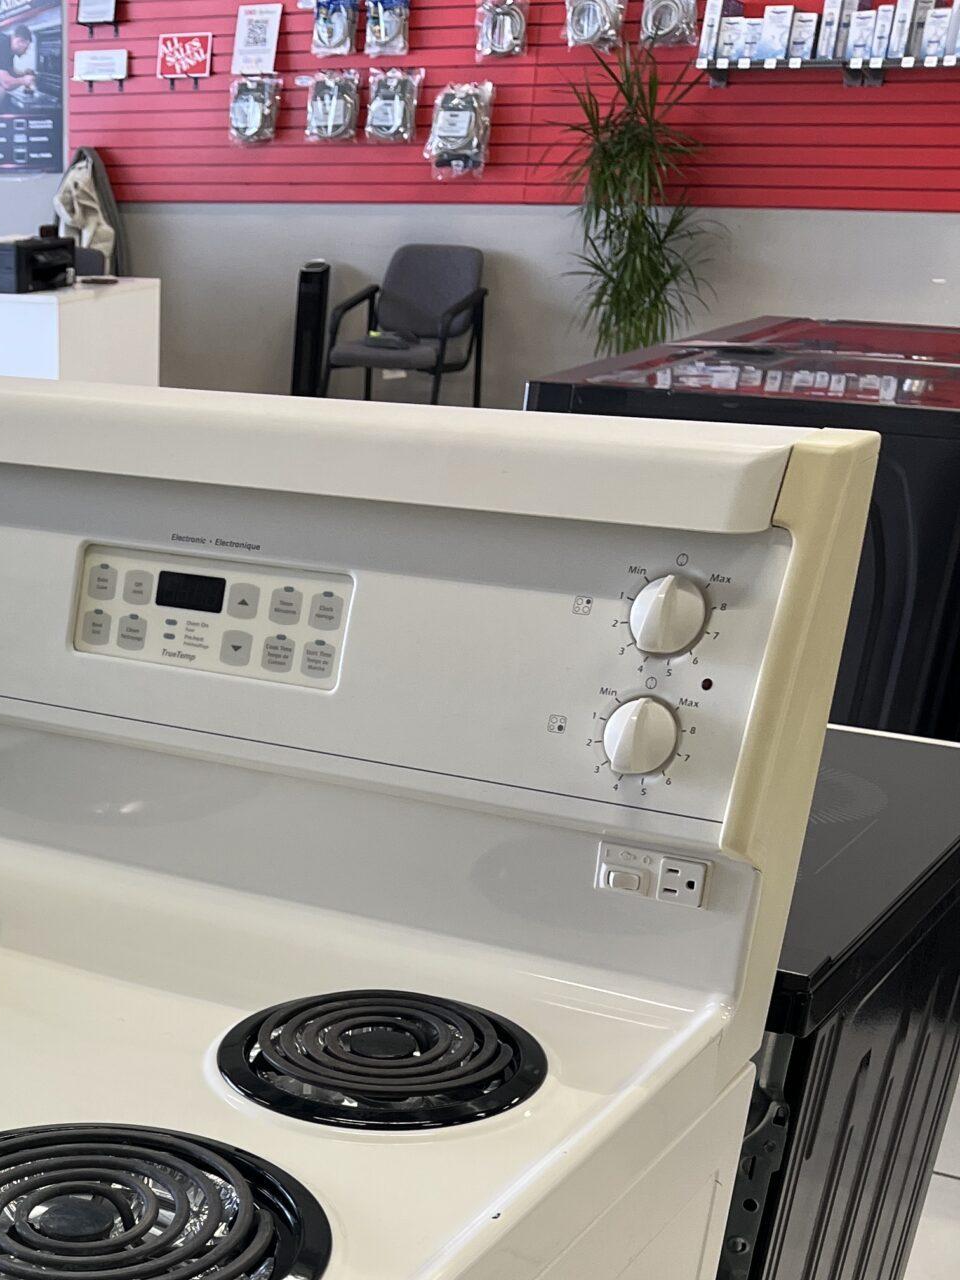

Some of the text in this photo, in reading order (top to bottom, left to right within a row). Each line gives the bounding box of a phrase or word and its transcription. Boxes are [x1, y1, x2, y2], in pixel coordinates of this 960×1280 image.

[171, 533, 261, 551] Electronic Electronique
[628, 566, 647, 575] Min
[709, 573, 732, 584] Max
[720, 603, 727, 611] 8
[612, 620, 619, 628] 2
[712, 631, 720, 640] 7
[161, 648, 197, 662] TrueTemp
[618, 647, 625, 656] 3
[692, 656, 699, 665] 6
[637, 665, 644, 673] 4
[665, 668, 672, 677] 5
[599, 687, 618, 696] Min
[678, 697, 700, 708] Max
[689, 726, 697, 735] 8
[585, 738, 593, 747] 2
[684, 753, 691, 762] 7
[593, 765, 600, 774] 3
[665, 777, 672, 786] 6
[612, 783, 619, 791] 4
[640, 788, 647, 796] 5
